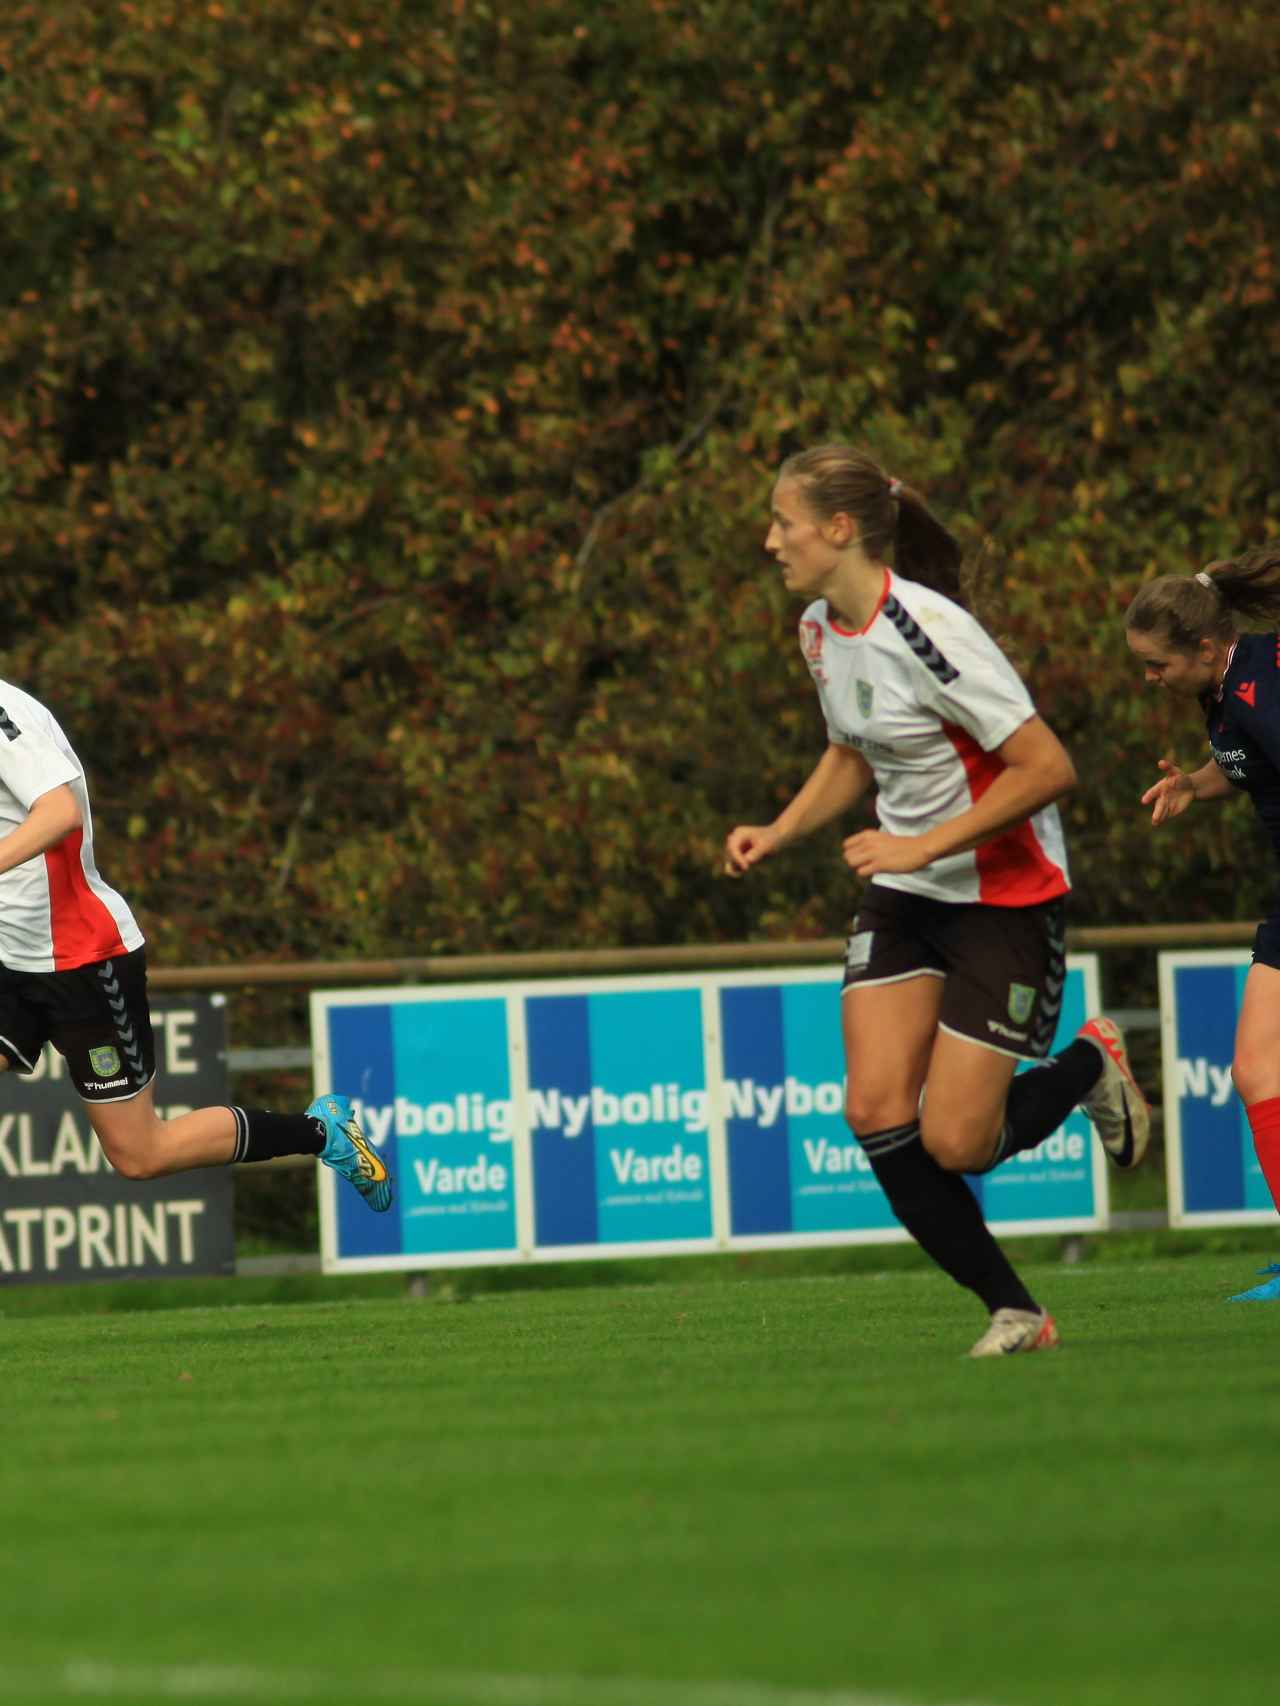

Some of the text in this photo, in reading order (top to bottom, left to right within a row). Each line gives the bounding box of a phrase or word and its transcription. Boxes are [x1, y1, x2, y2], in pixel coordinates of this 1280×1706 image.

[94, 1077, 129, 1090] hummel
[720, 1075, 848, 1128] Nybo
[525, 1083, 710, 1138] Nybolig
[414, 1155, 508, 1195] Varde
[611, 1144, 702, 1185] Varde
